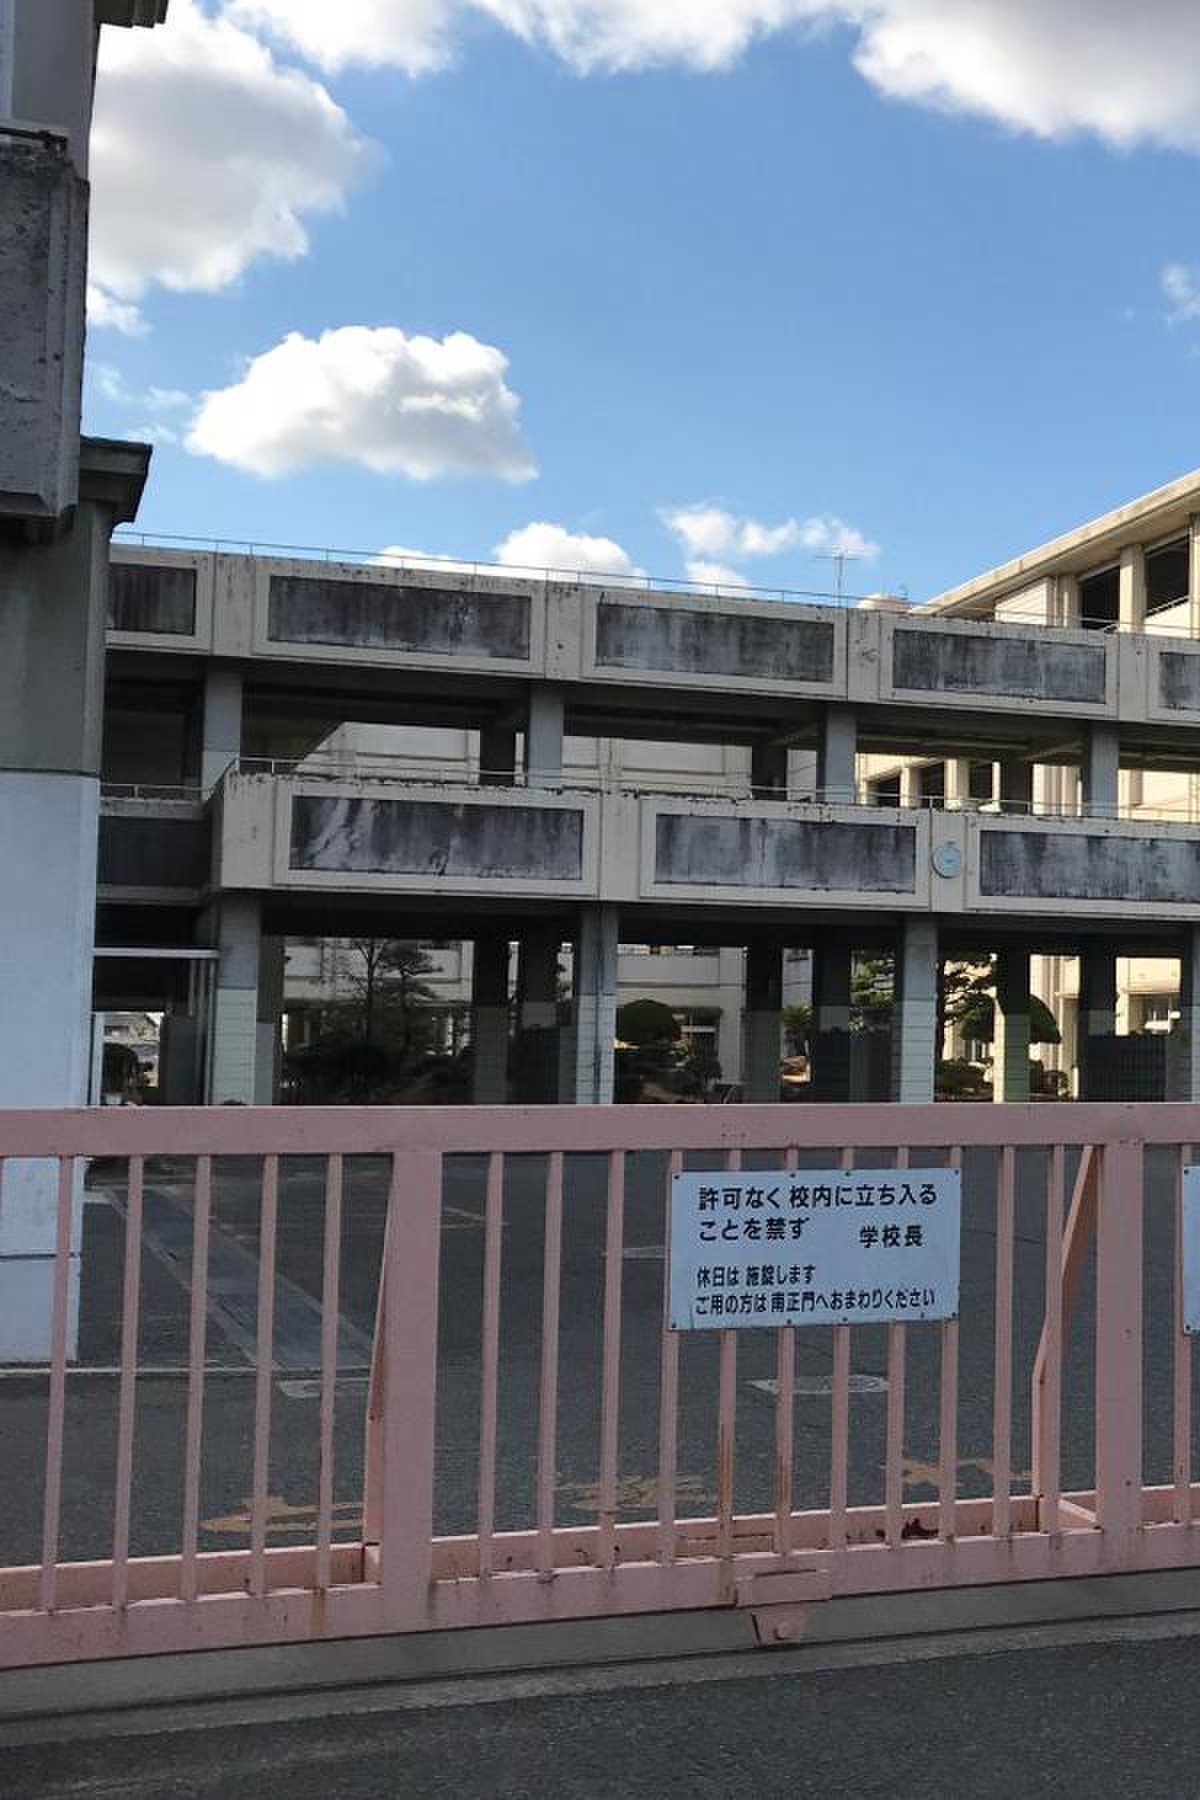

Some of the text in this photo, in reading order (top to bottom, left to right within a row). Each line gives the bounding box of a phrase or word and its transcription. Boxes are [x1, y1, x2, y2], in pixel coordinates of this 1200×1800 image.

[699, 1217, 810, 1241] ことを禁ず
[859, 1224, 924, 1249] 学校長
[695, 1288, 936, 1316] ご用の方は南正門へおまわりください
